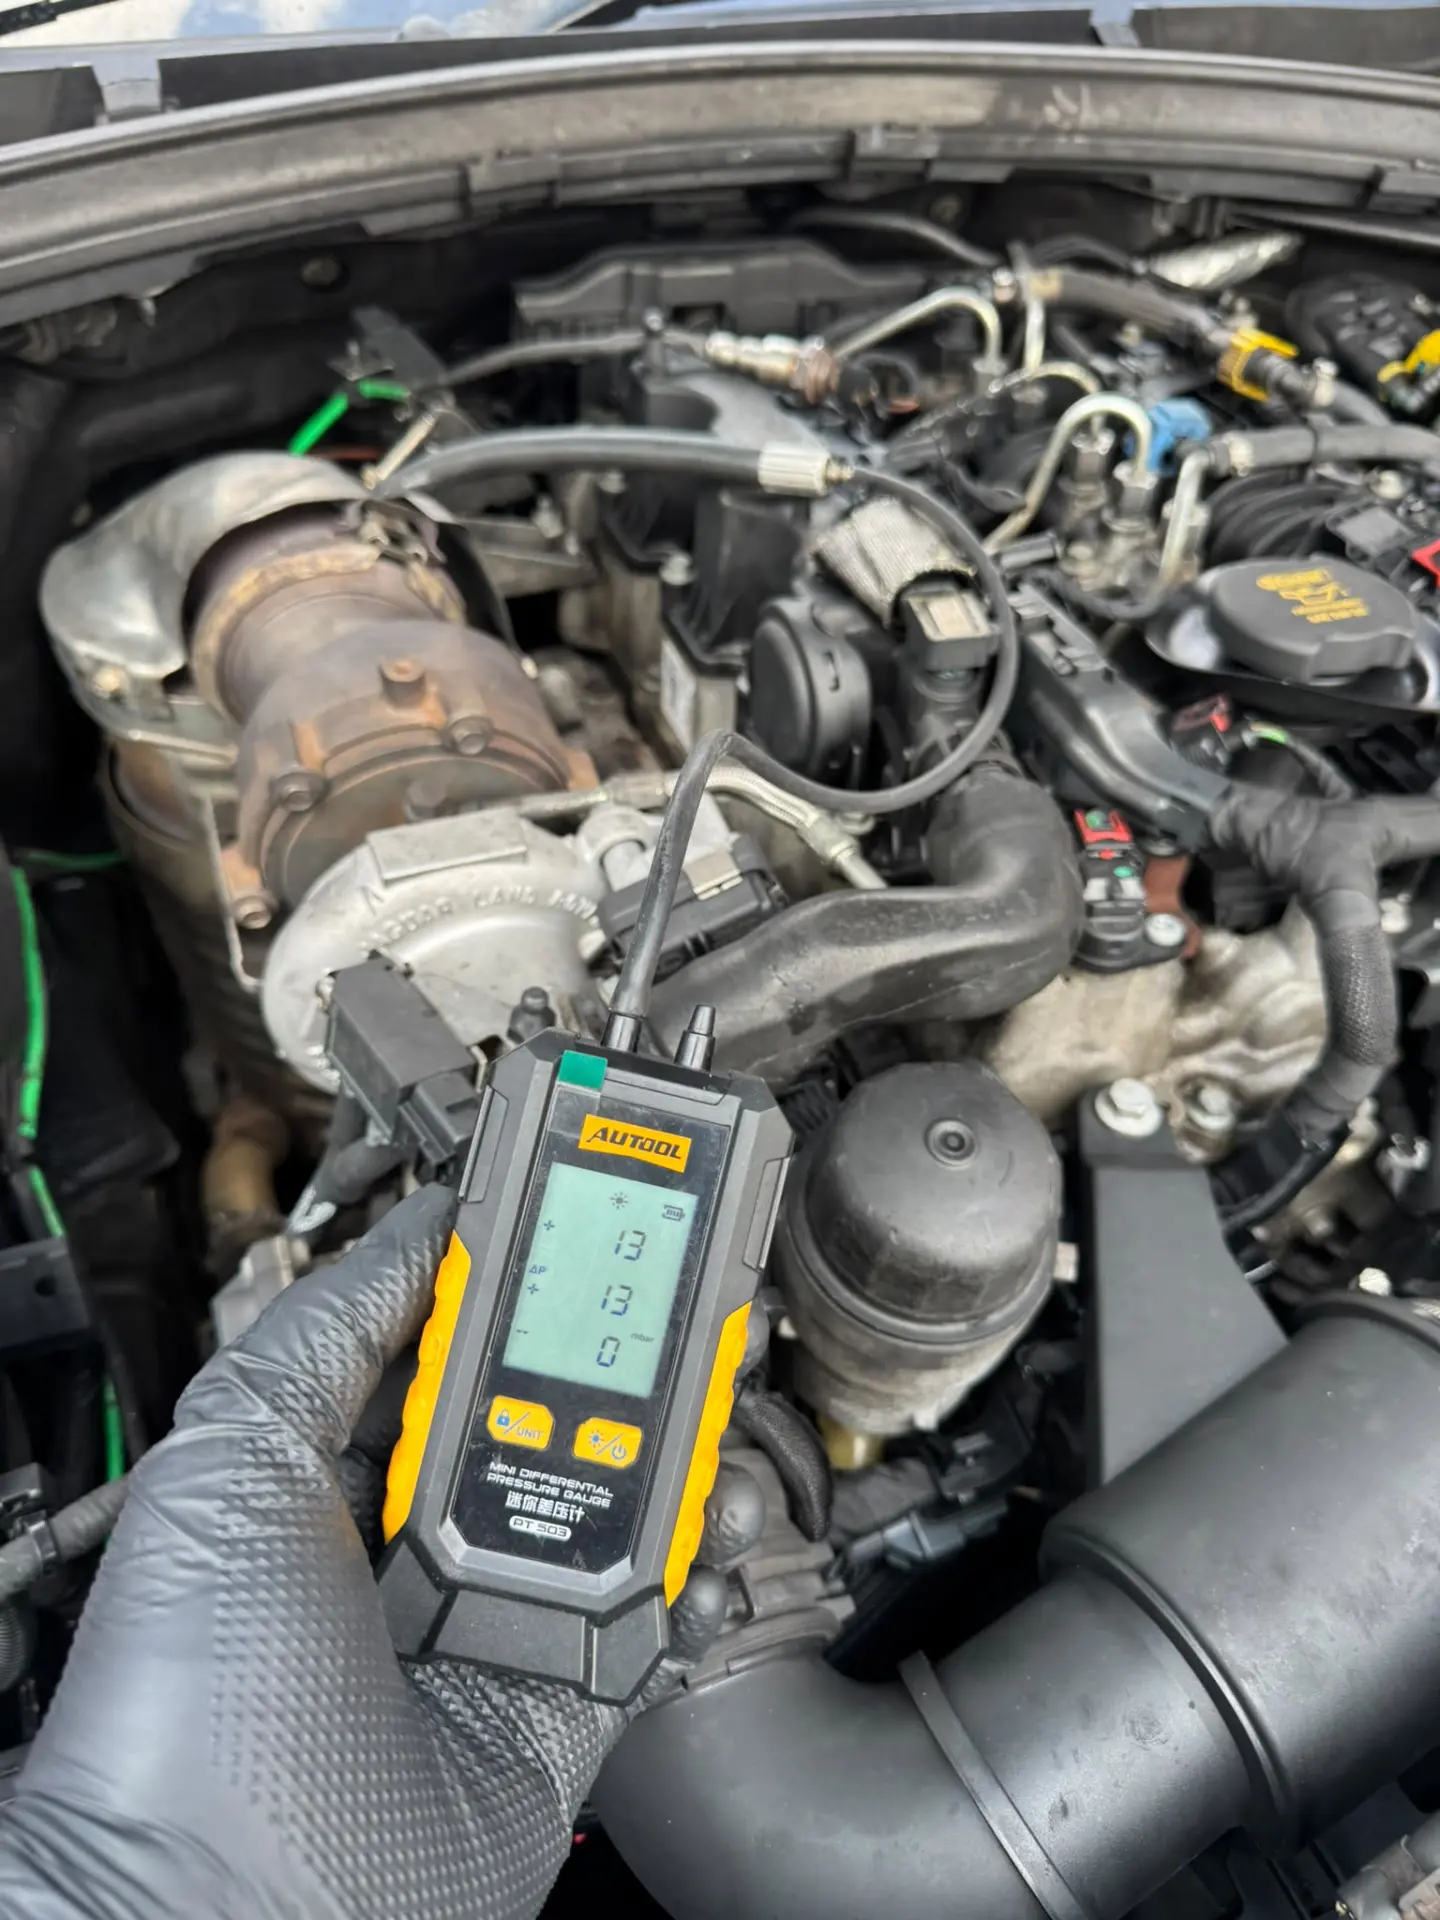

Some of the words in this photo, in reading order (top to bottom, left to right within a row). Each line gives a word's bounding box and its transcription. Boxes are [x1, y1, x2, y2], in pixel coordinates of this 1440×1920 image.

[586, 1126, 682, 1160] AUTOOL
[614, 1229, 647, 1261] 13
[600, 1284, 634, 1316] 13
[596, 1335, 621, 1368] 0
[630, 1332, 655, 1343] mbar
[516, 1426, 545, 1441] UNIT
[486, 1472, 561, 1497] PRESSURE
[563, 1489, 612, 1509] GAUGE
[489, 1461, 517, 1475] MINI
[519, 1468, 614, 1498] DIFFERENTIAL
[504, 1489, 585, 1524] 迷你差压计
[513, 1517, 535, 1530] PT
[536, 1523, 567, 1538] 503
